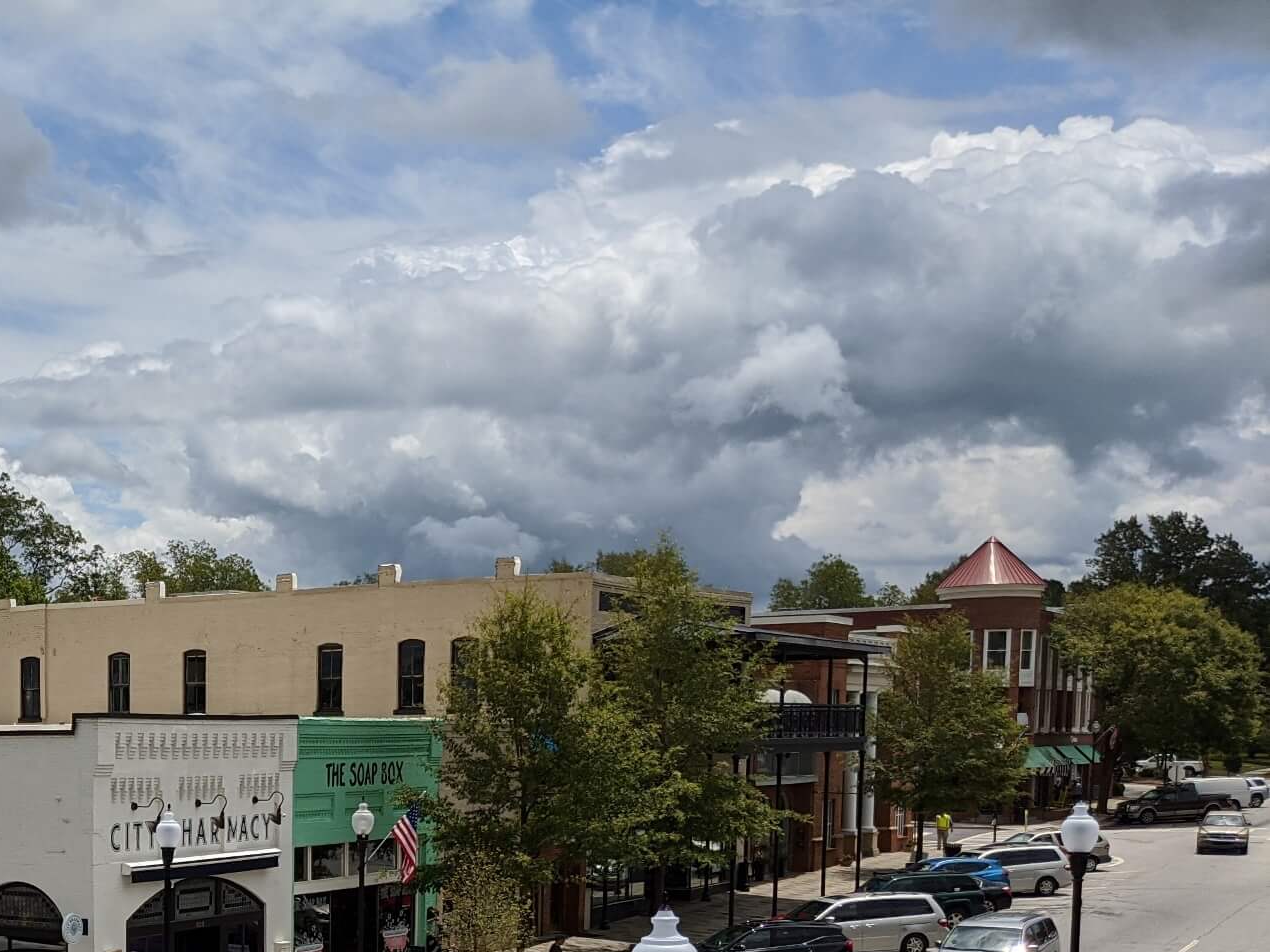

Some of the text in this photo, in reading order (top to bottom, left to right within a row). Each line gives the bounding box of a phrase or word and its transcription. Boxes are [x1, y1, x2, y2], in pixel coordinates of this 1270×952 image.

[326, 760, 404, 787] THE SOAP BOX
[181, 812, 271, 849] HARMACY
